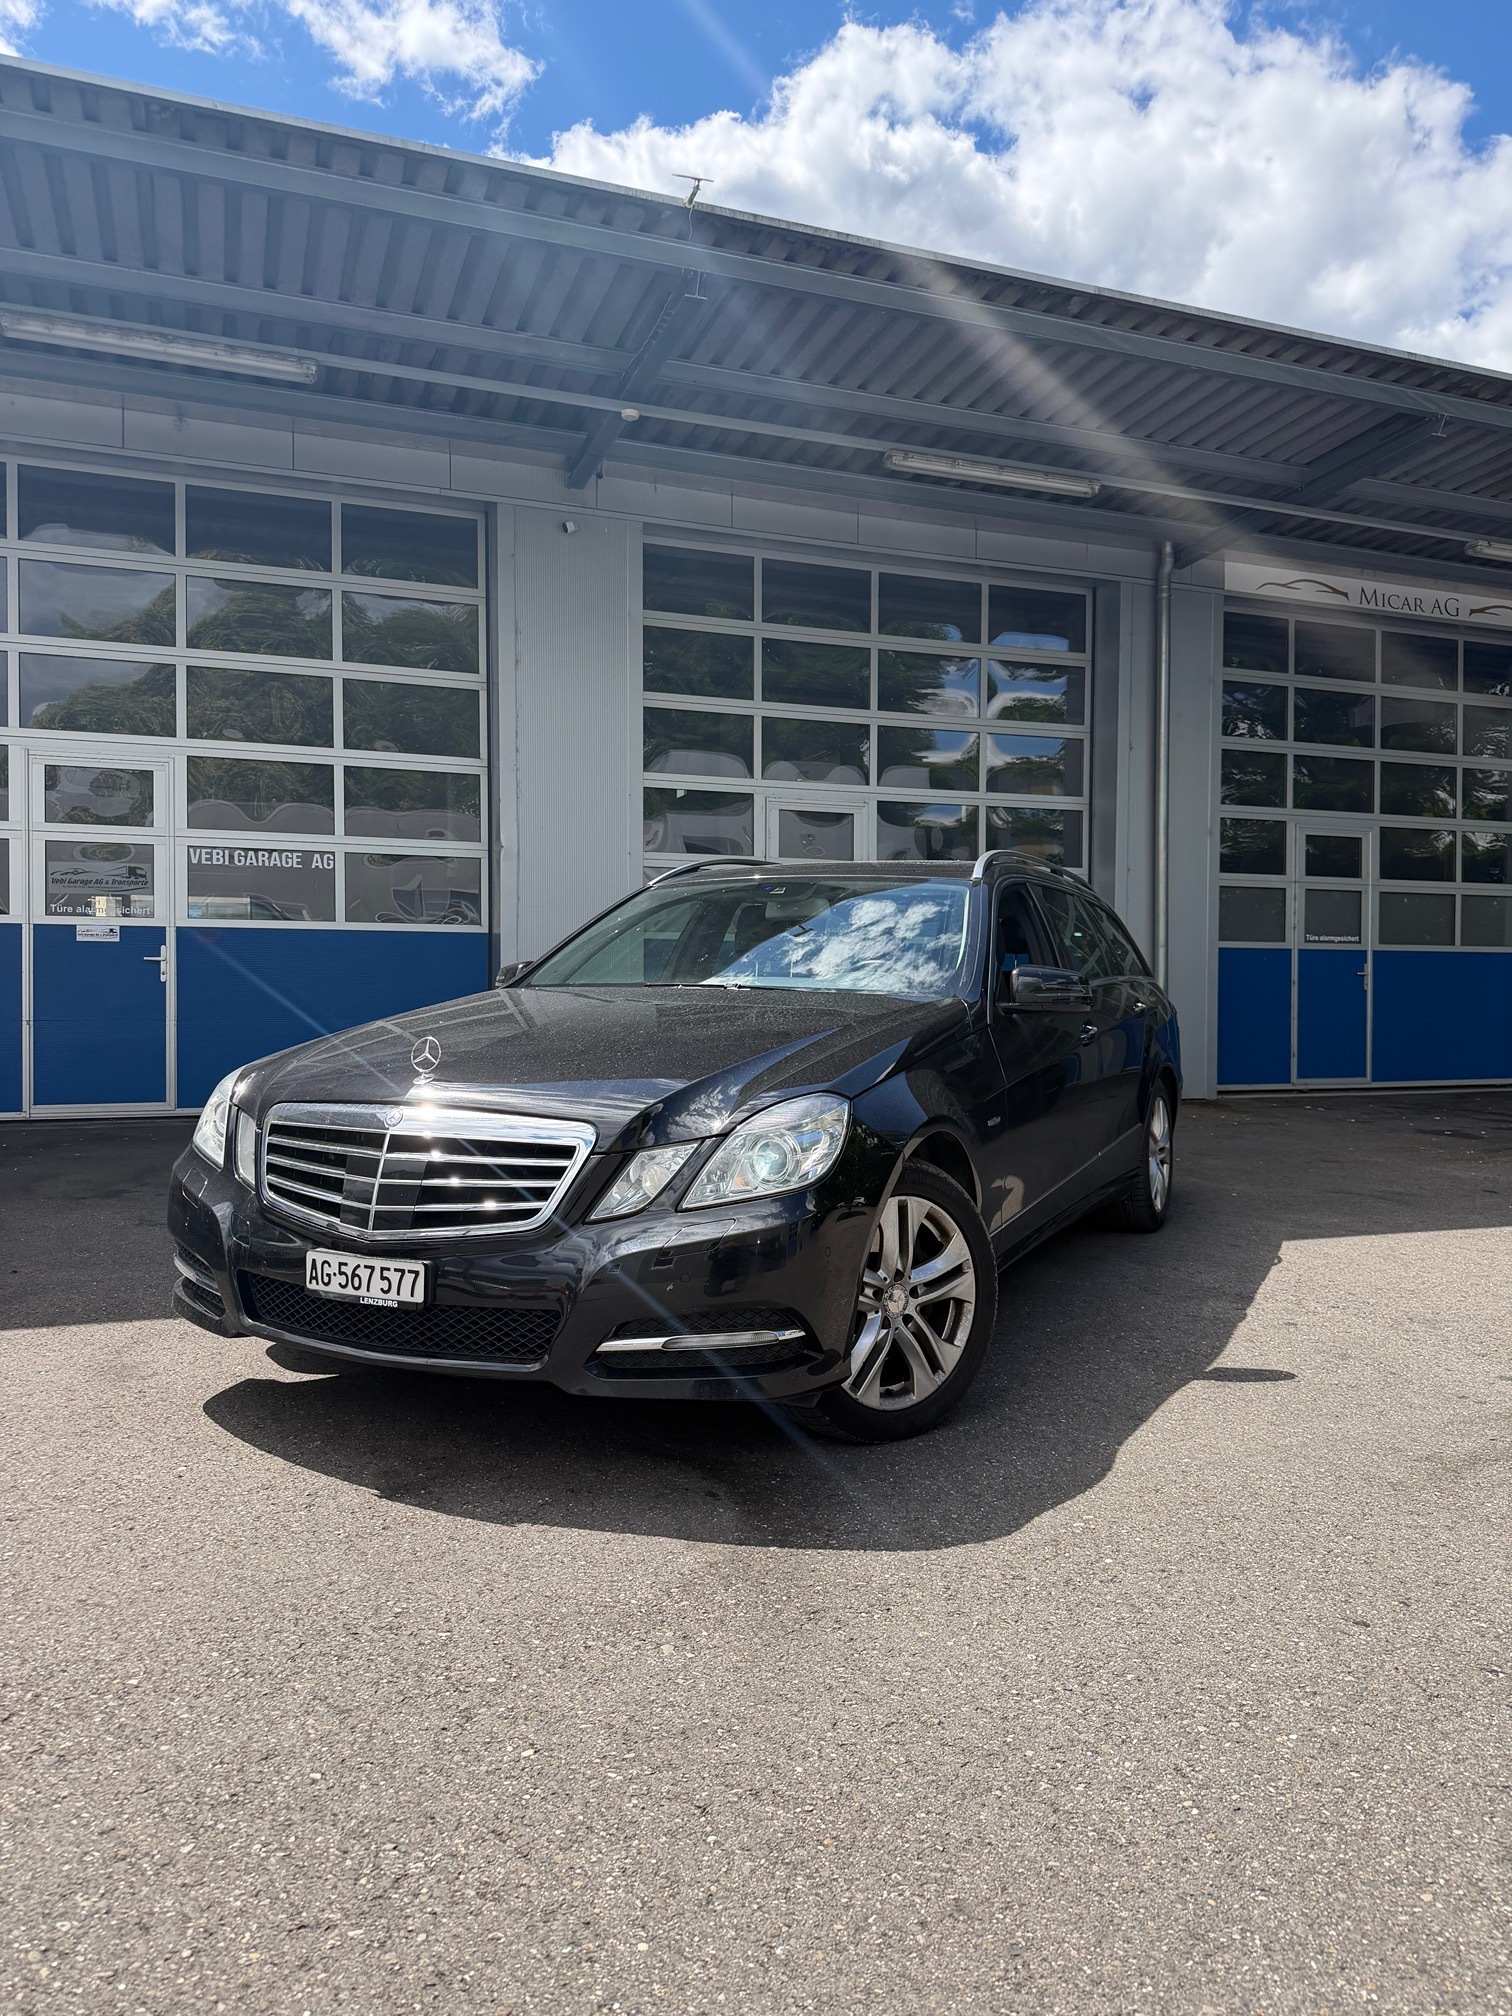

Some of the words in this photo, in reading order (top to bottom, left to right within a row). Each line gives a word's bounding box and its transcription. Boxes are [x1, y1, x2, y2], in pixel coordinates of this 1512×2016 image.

[1431, 597, 1460, 617] AG
[189, 848, 229, 865] VEBI
[234, 850, 303, 868] GARAGE
[311, 853, 334, 869] AG
[51, 877, 67, 885] Vebi
[67, 878, 93, 887] Garage
[111, 879, 149, 887] Transporte
[50, 904, 73, 913] Türe
[76, 905, 150, 915] alarmsichert
[360, 1297, 399, 1308] LENZBURG
